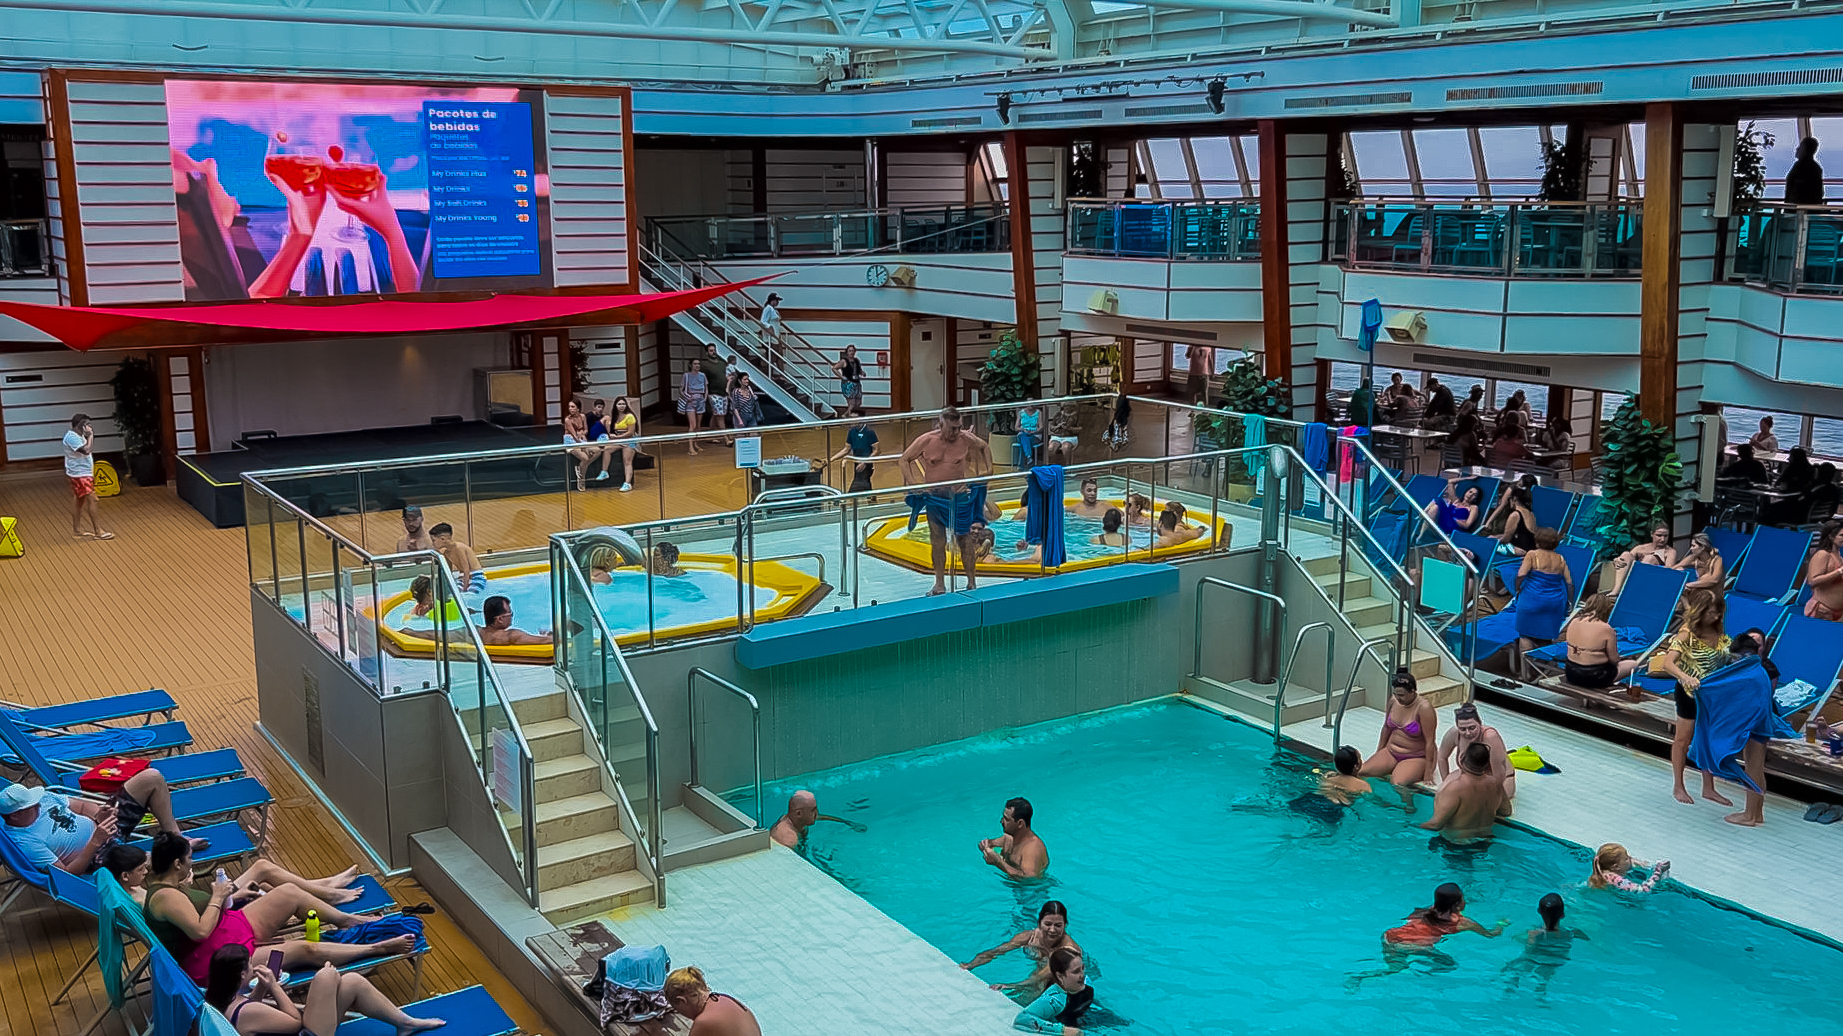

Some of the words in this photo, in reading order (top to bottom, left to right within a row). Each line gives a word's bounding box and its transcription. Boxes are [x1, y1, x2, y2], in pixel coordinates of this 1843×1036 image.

[429, 108, 479, 119] Pacotes
[482, 109, 498, 119] de
[429, 121, 480, 131] bebidas
